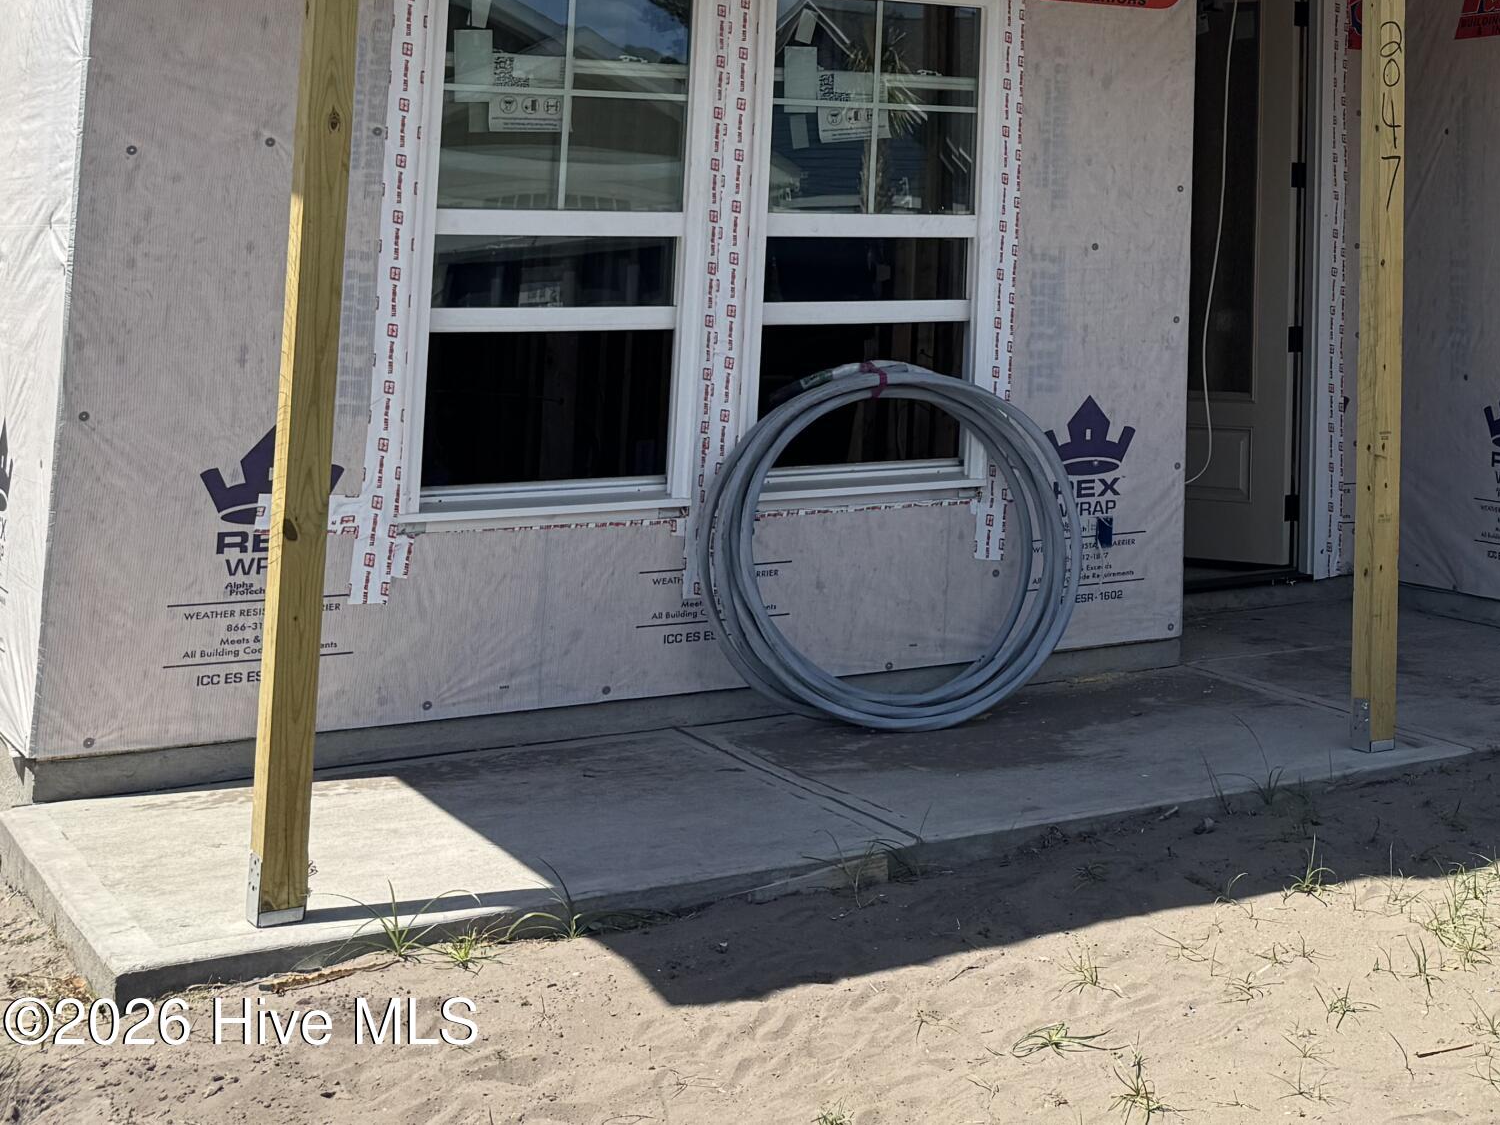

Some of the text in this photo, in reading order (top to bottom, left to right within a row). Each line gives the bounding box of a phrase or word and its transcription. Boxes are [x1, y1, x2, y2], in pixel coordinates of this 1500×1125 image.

[1380, 21, 1402, 211] 2047
[216, 530, 269, 554] RE
[184, 610, 235, 620] WEATHER
[220, 636, 260, 646] Meets &
[663, 633, 700, 644] ICC ES
[183, 648, 239, 659] All Building
[197, 674, 220, 686] ICC
[225, 673, 242, 684] ES
